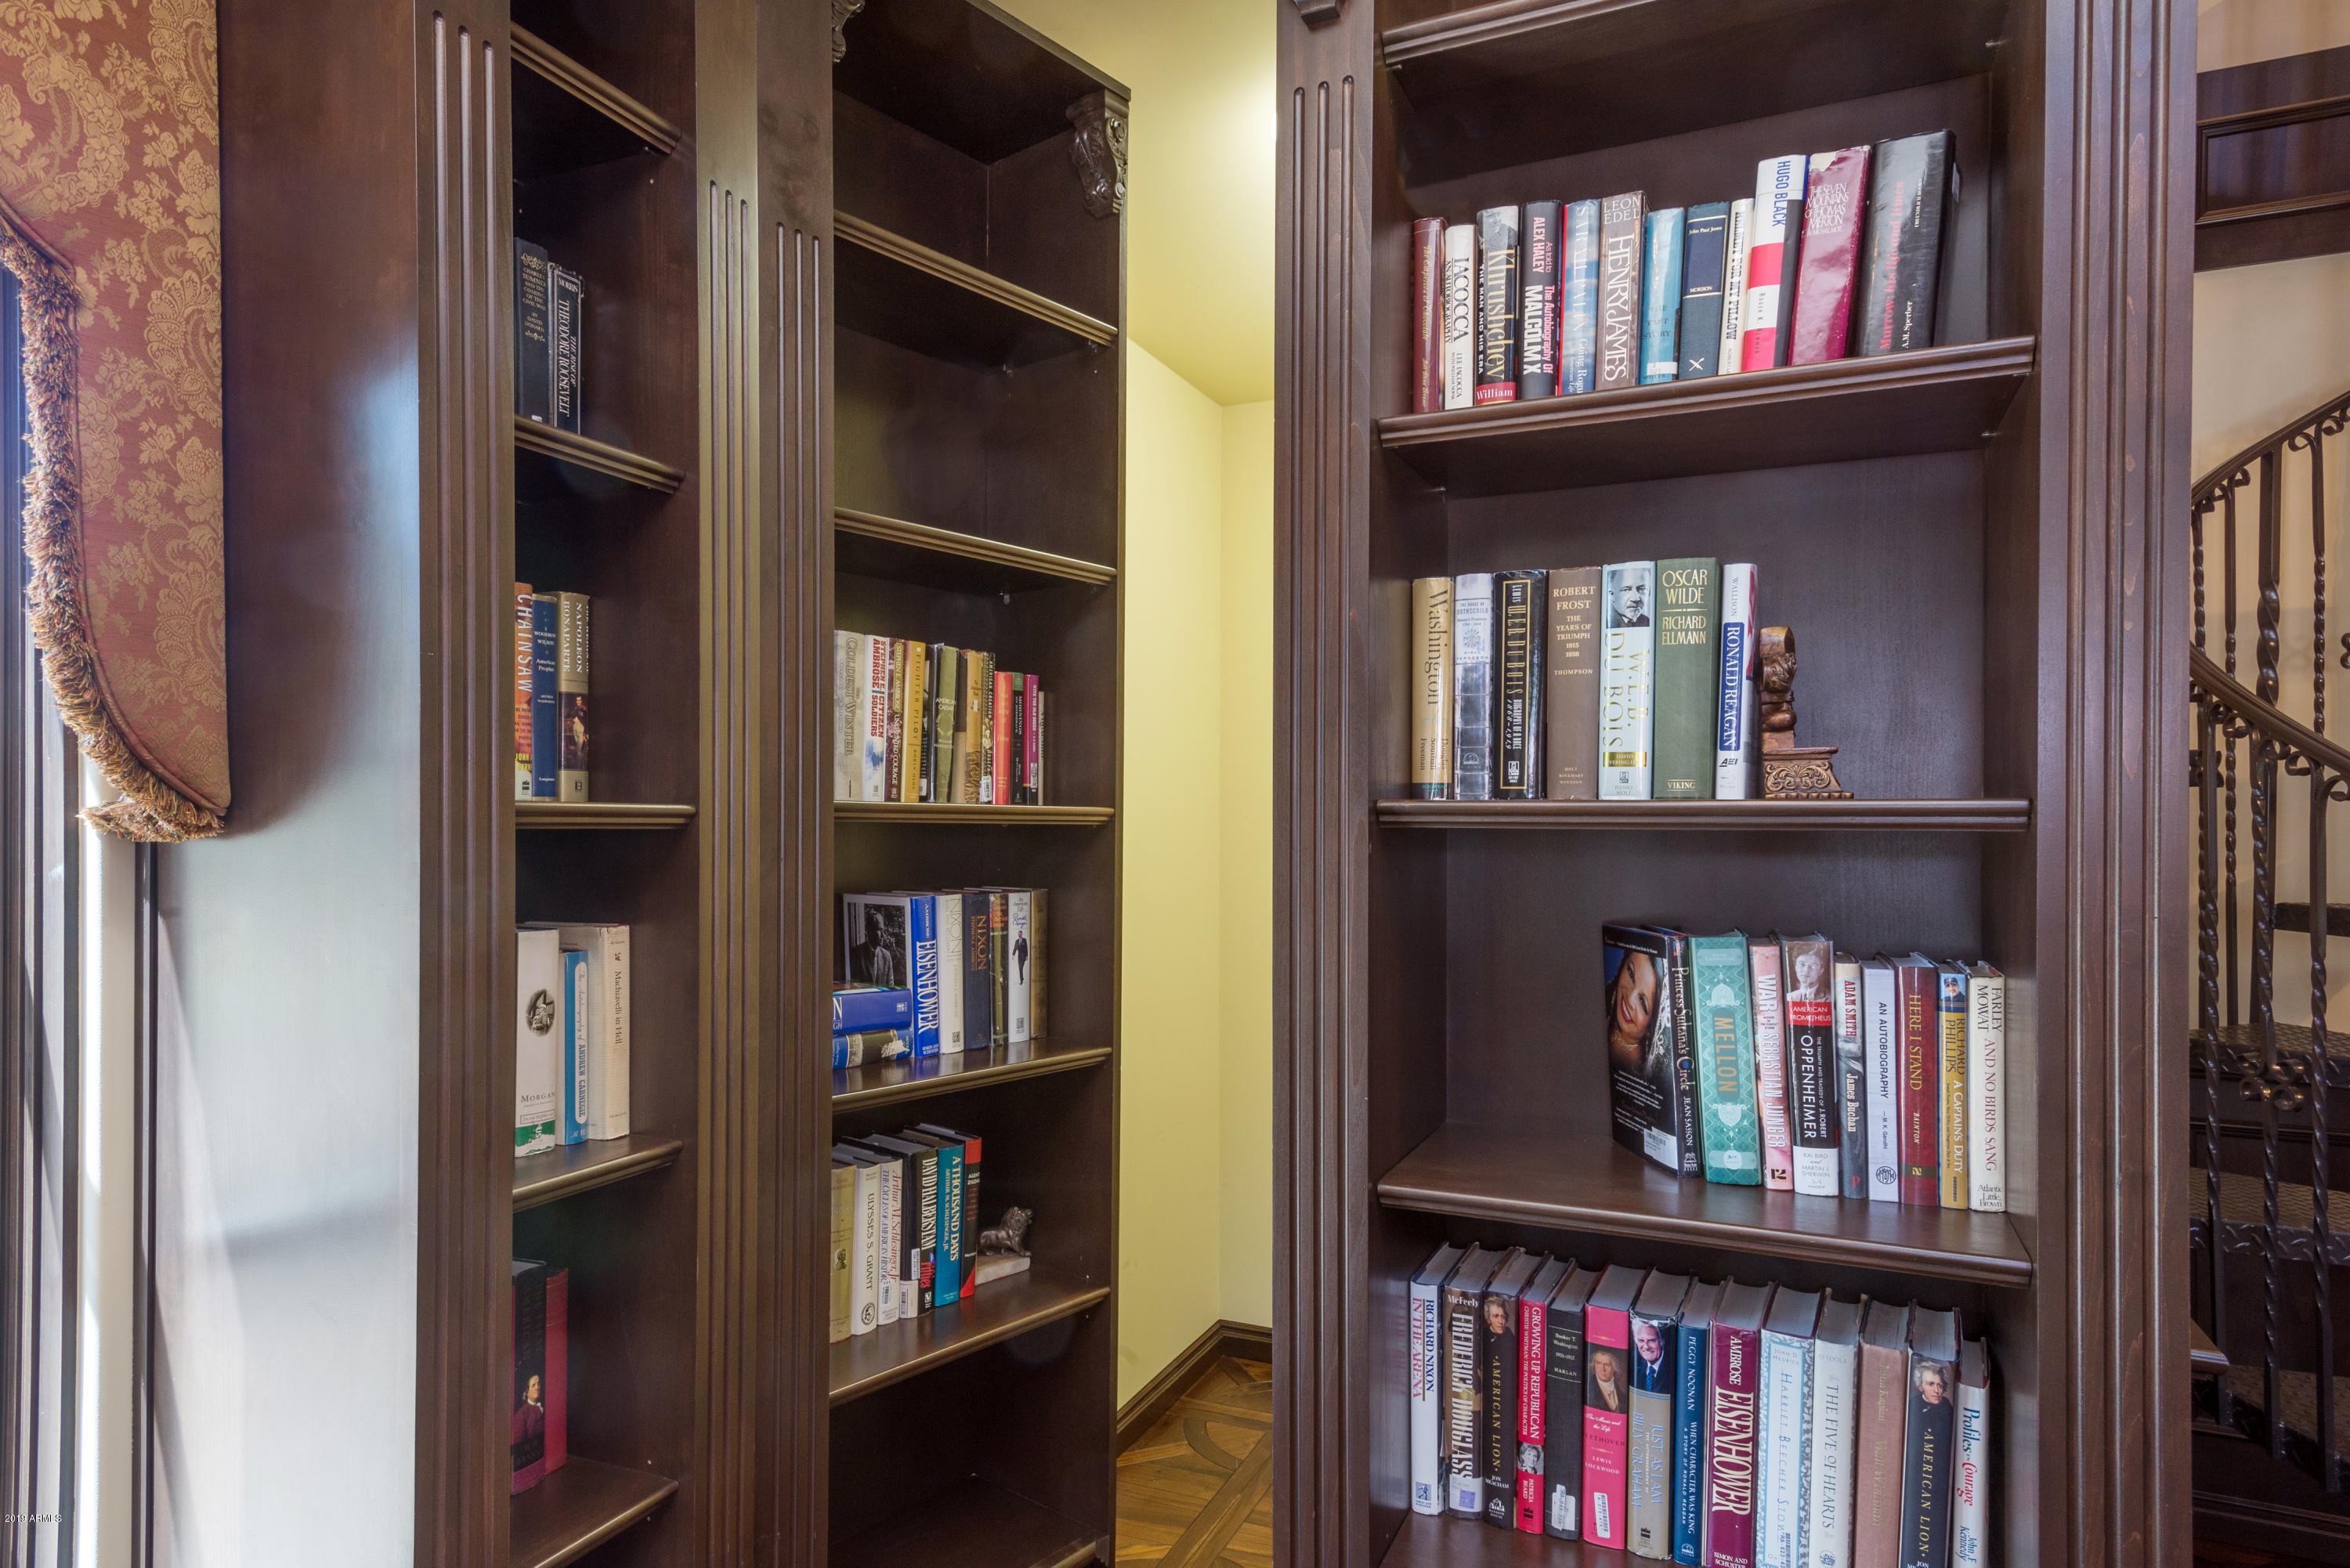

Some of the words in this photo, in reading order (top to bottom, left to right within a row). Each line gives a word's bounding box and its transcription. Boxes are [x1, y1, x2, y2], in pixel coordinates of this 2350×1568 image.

[1776, 161, 1791, 190] HUGO
[1603, 197, 1640, 212] LEON
[1604, 211, 1640, 224] EDEL
[1773, 193, 1788, 227] BLACK
[1534, 217, 1546, 241] ALEX
[1546, 242, 1552, 252] As
[1891, 220, 1901, 243] and
[1533, 243, 1545, 273] HALEY
[1606, 235, 1635, 310] HENRY
[1887, 245, 1900, 270] life
[559, 278, 579, 293] MORRIS
[1453, 257, 1470, 342] IACOCCA
[1545, 286, 1555, 301] The
[1885, 273, 1896, 292] his
[559, 301, 569, 357] THEODORE
[1487, 249, 1515, 380] Khrushchev
[1524, 286, 1542, 360] MALCOLM
[1542, 302, 1555, 361] Autobiography
[1880, 295, 1894, 349] Murrow:
[1603, 309, 1632, 381] JAMES
[1524, 362, 1542, 374] X
[1543, 363, 1553, 374] Of
[559, 358, 569, 417] ROOSEVELT
[1477, 388, 1513, 401] William
[1553, 586, 1596, 597] ROBERT
[1662, 569, 1708, 587] OSCAR
[1666, 587, 1705, 604] WILDE
[1556, 600, 1591, 610] FROST
[1662, 616, 1706, 630] RICHARD
[518, 594, 532, 692] CHAINSAW
[1424, 590, 1448, 705] Washington
[1605, 633, 1625, 670] DU
[1662, 631, 1706, 645] ELLMANN
[1726, 627, 1740, 687] RONALD
[846, 638, 858, 698] COLDEST
[872, 638, 881, 688] AMBROSE
[1628, 649, 1650, 727] W.E.B.
[845, 701, 856, 756] WINTER
[1603, 686, 1624, 747] BOIS
[1723, 689, 1737, 747] REAGAN
[949, 898, 962, 953] NIXON
[977, 915, 987, 970] NIXON
[916, 939, 939, 1035] EISENHOWER
[1672, 967, 1689, 1007] Princess
[1758, 974, 1780, 1012] WAR
[1845, 980, 1856, 1006] ADAM
[1845, 1008, 1857, 1037] SMITH
[1879, 1002, 1887, 1015] AN
[1909, 995, 1922, 1031] HERE
[1977, 985, 1990, 1032] MOWAT
[1991, 987, 2003, 1033] FARLEY
[1674, 1008, 1692, 1054] Sultana's
[1945, 1020, 1956, 1072] PHILLIPS
[1956, 1018, 1967, 1075] RICHARD
[1714, 1017, 1737, 1092] MELLON
[1762, 1033, 1783, 1097] SEBASTIAN
[1879, 1019, 1889, 1099] AUTOBIOGRAPHY
[1909, 1046, 1923, 1091] STAND
[1984, 1039, 1996, 1068] AND
[1676, 1057, 1694, 1091] Circle
[1800, 1035, 1816, 1138] OPPENHEIMER
[1846, 1074, 1856, 1100] James
[1954, 1081, 1964, 1090] A
[1984, 1072, 1996, 1093] NO
[520, 1091, 556, 1103] MORGAN
[1984, 1096, 1997, 1133] BIRDS
[1685, 1118, 1694, 1146] SASSON
[1766, 1102, 1786, 1148] JUNGER
[1847, 1101, 1857, 1133] Buchan
[1953, 1092, 1964, 1143] CAPTAIN'S
[922, 1158, 937, 1186] DAVID
[1952, 1144, 1964, 1173] DUTY
[1984, 1136, 1997, 1172] SANG
[951, 1165, 960, 1231] THOUSAND
[921, 1187, 937, 1250] HALBERSTAM
[866, 1241, 873, 1252] S.
[950, 1234, 960, 1261] DAYS
[1448, 1295, 1479, 1308] McFeely
[1426, 1299, 1435, 1352] RICHARD
[1531, 1307, 1542, 1358] GROWING
[1452, 1313, 1473, 1395] FREDERICK
[1531, 1360, 1541, 1374] UP
[1688, 1336, 1697, 1365] PEGGY
[1730, 1336, 1742, 1385] AMBROSE
[1425, 1354, 1434, 1393] NIXON
[1687, 1368, 1696, 1411] NOONAN
[1492, 1360, 1502, 1429] AMERICAN
[1530, 1375, 1541, 1439] REPUBLICAN
[1827, 1385, 1838, 1416] THE
[1451, 1398, 1473, 1479] DOUGLASS
[1632, 1412, 1645, 1447] BILLY
[1825, 1418, 1838, 1451] FIVE
[1962, 1407, 1980, 1453] Profiles
[1492, 1434, 1502, 1467] LION
[1712, 1386, 1754, 1516] EISENHOWER
[1824, 1454, 1837, 1472] OF
[1630, 1448, 1644, 1508] GRAHAM
[1921, 1433, 1934, 1509] AMERICAN
[1957, 1461, 1978, 1506] Courage
[1821, 1474, 1836, 1530] HEARTS
[1918, 1516, 1931, 1552] LION
[1955, 1526, 1969, 1562] Kennedy
